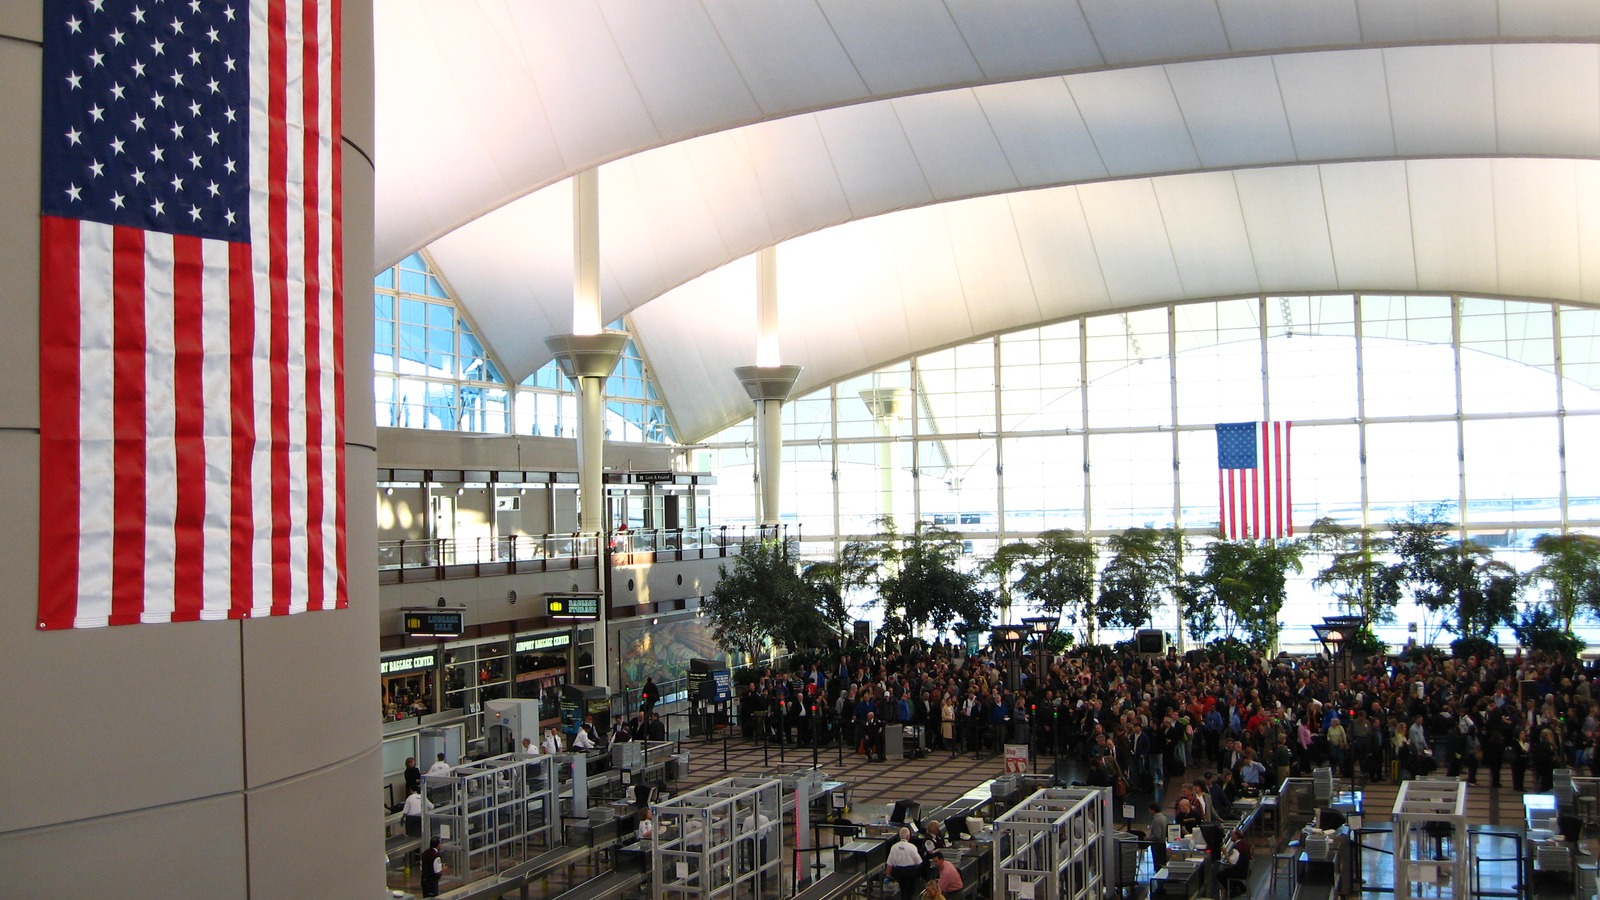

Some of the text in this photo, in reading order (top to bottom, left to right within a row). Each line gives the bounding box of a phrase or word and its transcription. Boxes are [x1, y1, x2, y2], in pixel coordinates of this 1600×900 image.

[428, 615, 459, 623] LUGGAGE
[434, 623, 453, 631] SALE
[516, 635, 569, 652] AIRPORT BAGGAGE CENTER
[389, 659, 413, 672] BAGGAGE
[413, 655, 434, 668] CENTER
[1006, 748, 1016, 756] Stop
